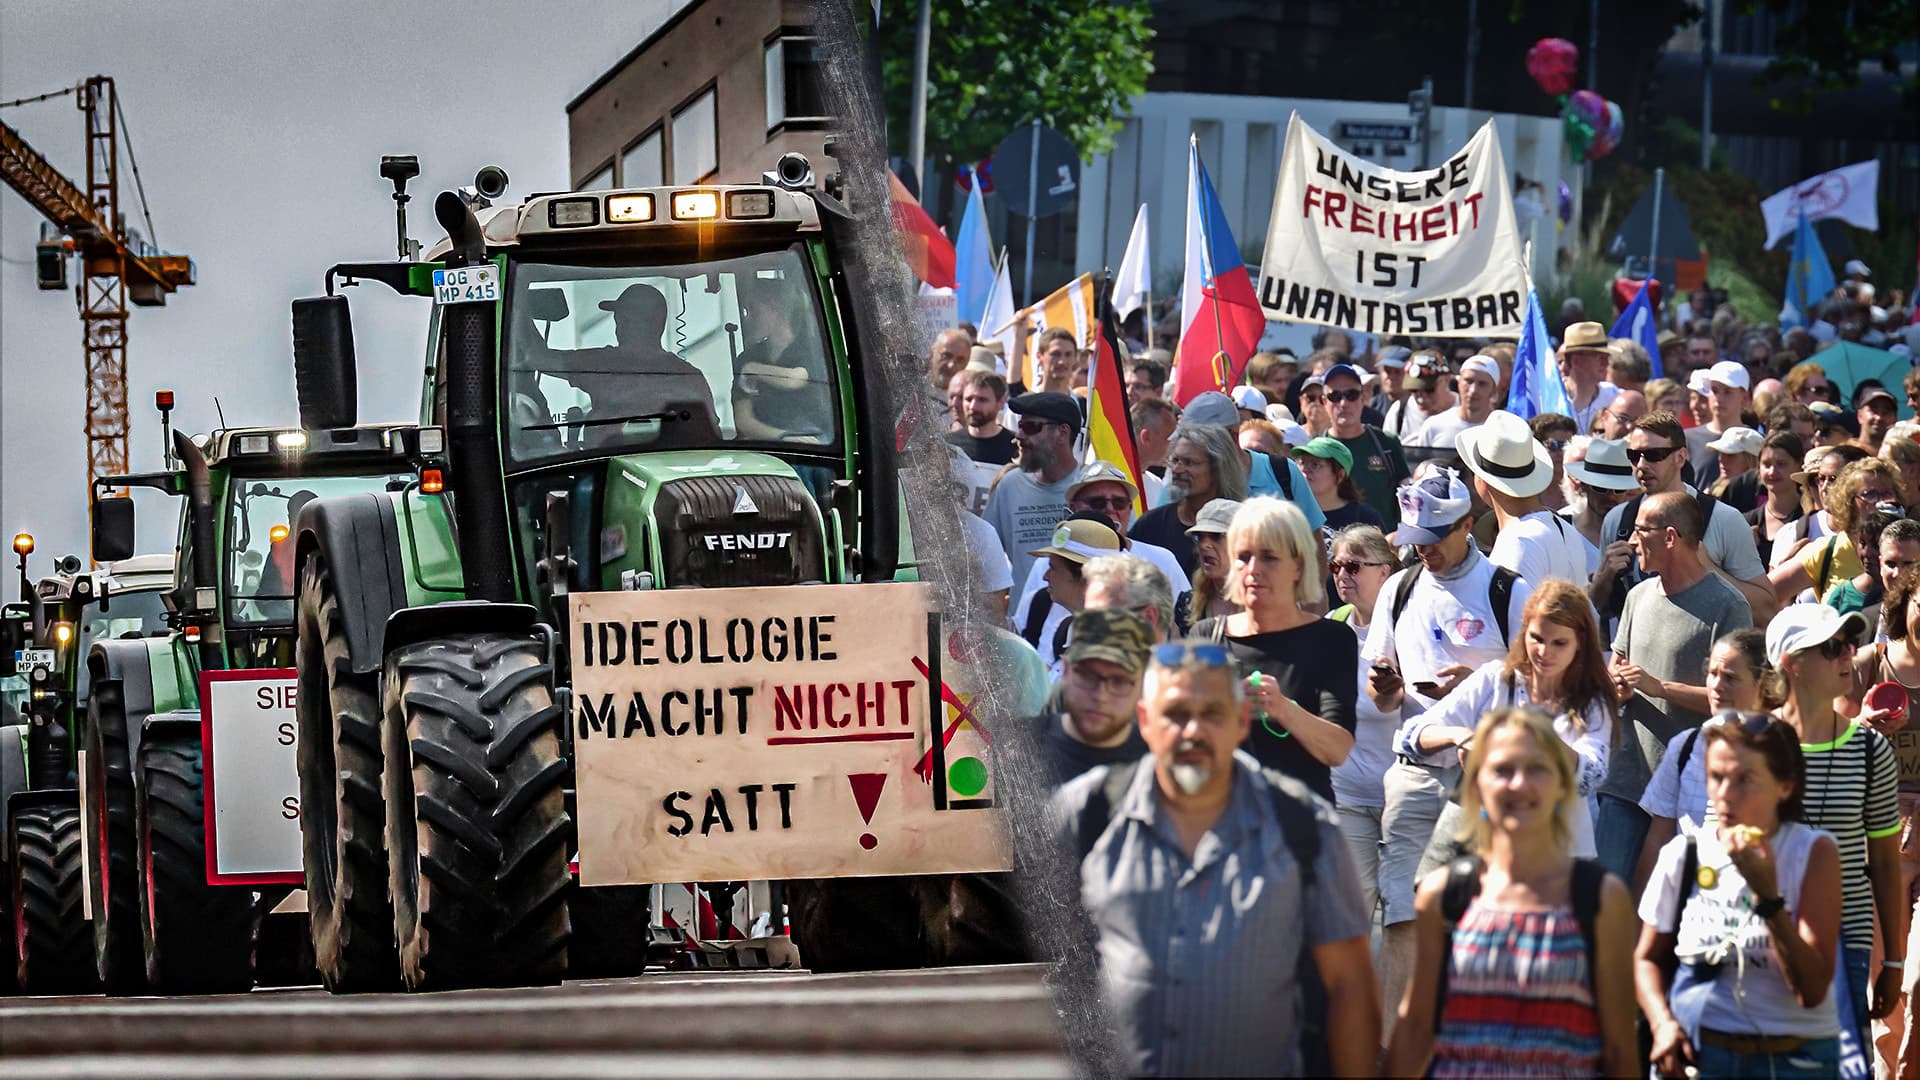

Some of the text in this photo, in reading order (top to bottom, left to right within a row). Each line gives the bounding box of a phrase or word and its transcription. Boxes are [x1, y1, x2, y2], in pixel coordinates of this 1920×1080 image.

[1316, 147, 1469, 202] UNSERE
[1303, 184, 1484, 241] FREIHEIT
[439, 283, 495, 302] MP 415
[447, 271, 467, 286] OG
[1356, 250, 1426, 288] IST
[1260, 276, 1521, 333] UNANTASTBAR
[703, 532, 792, 551] FENDT
[25, 653, 38, 661] OG
[582, 615, 838, 667] IDEOLOGIE
[578, 680, 915, 739] MACHT NICHT
[662, 783, 796, 838] SATT
